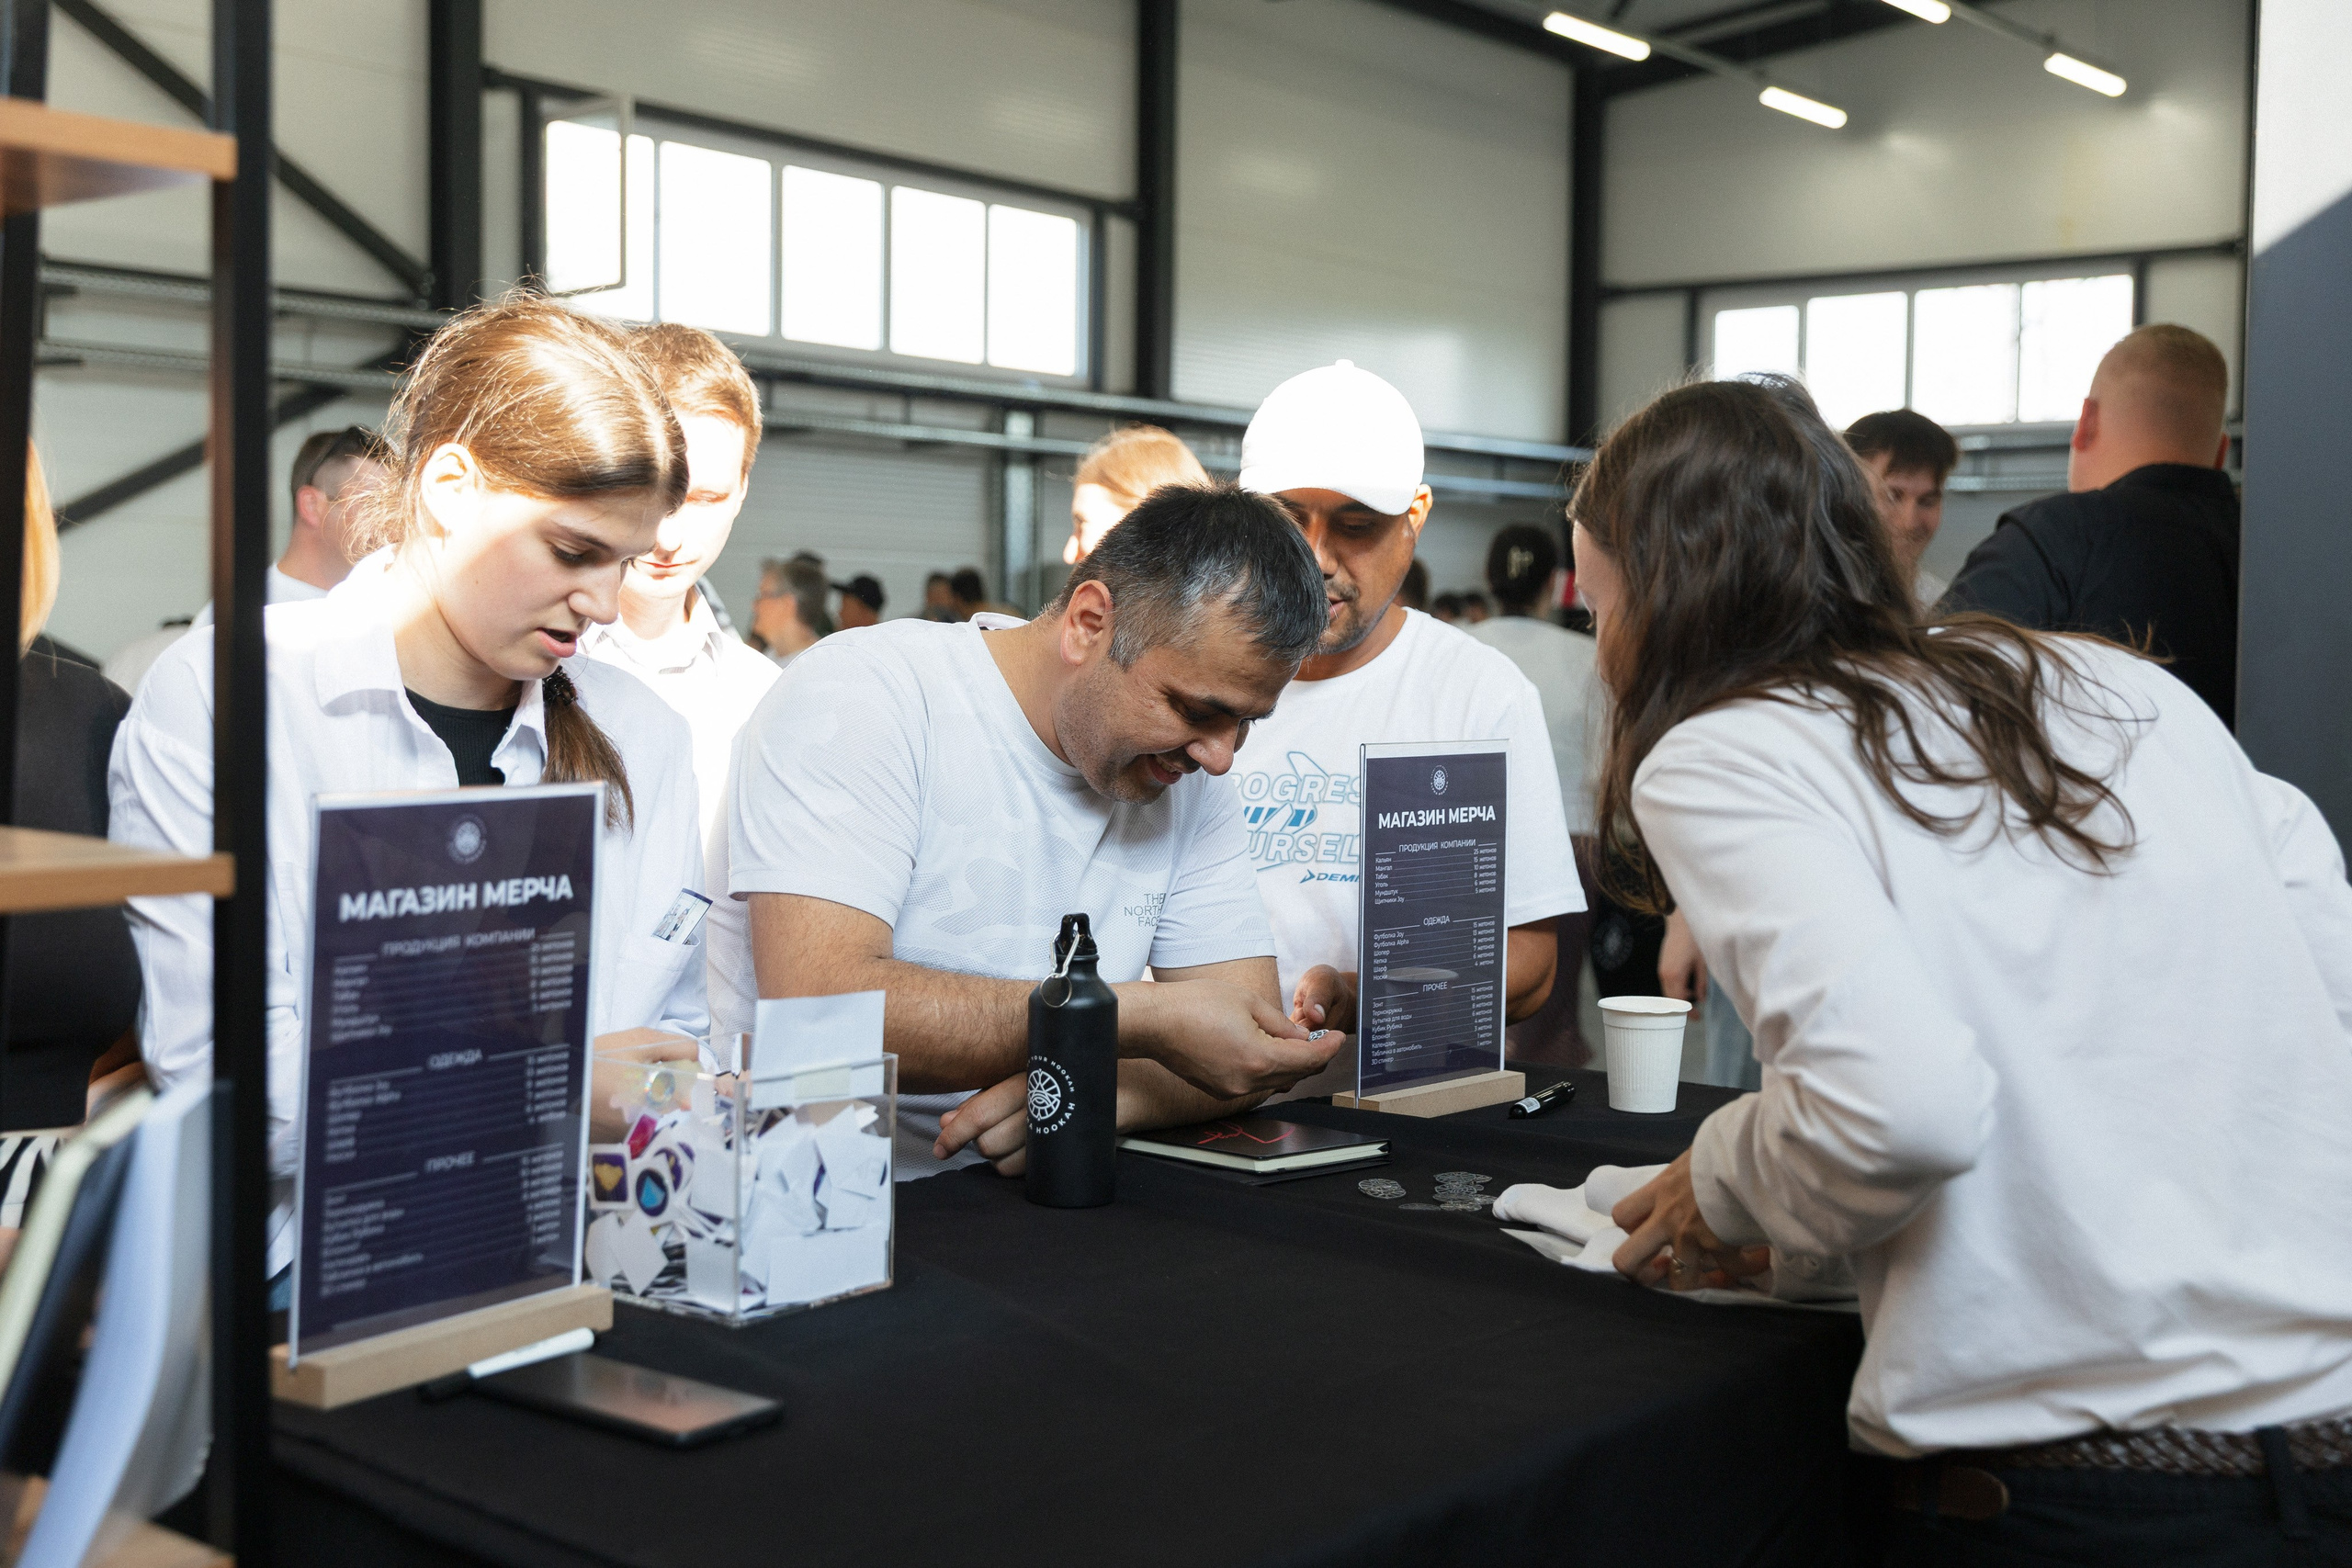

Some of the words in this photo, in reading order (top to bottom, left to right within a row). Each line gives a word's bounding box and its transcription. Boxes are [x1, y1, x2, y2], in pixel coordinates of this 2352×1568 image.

[1379, 809, 1445, 829] МАГАЗИН
[1449, 806, 1496, 824] МЕРЧА
[1399, 842, 1438, 852] ПРОДУКЦИЯ
[1441, 839, 1476, 849] КОМПАНИИ
[339, 882, 478, 923] МАГАЗИН
[482, 874, 573, 908] МЕРЧА
[1423, 916, 1450, 926] ОДЕЖДА
[1374, 932, 1396, 941] Футболка
[1374, 941, 1396, 949] Футболка
[1423, 982, 1447, 992] ПРОЧЕЕ
[1036, 1102, 1076, 1134] HOOKAH
